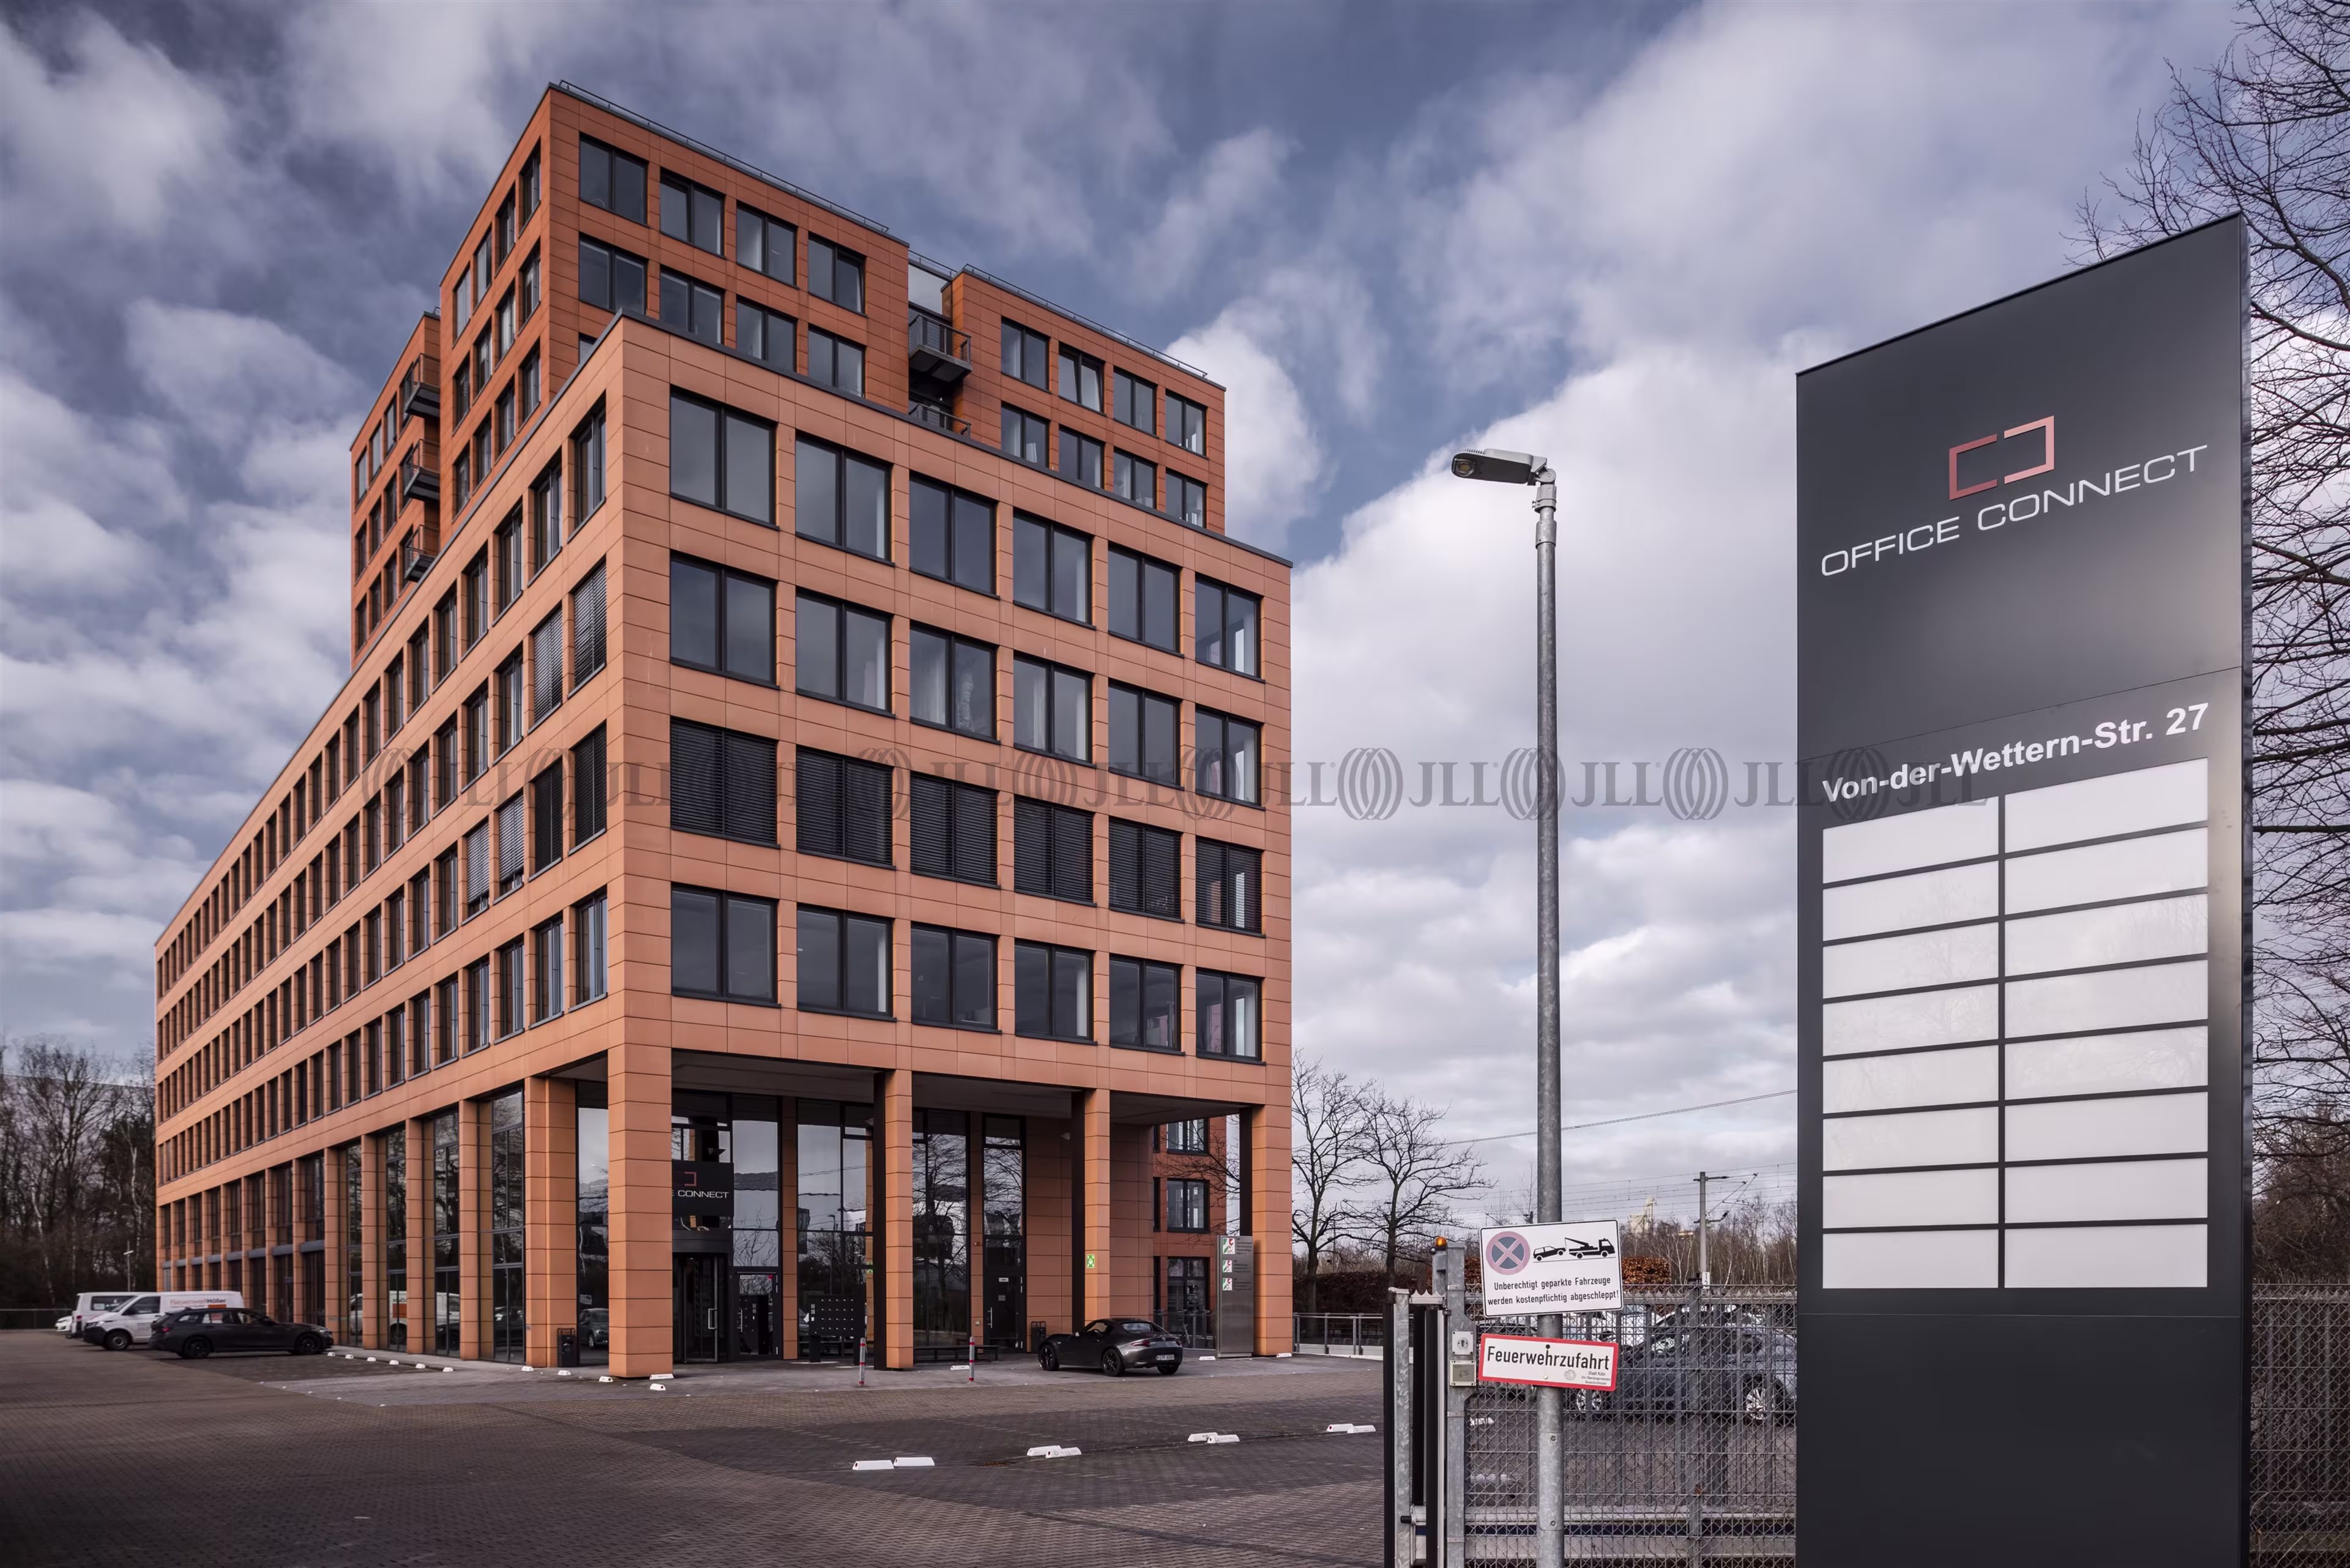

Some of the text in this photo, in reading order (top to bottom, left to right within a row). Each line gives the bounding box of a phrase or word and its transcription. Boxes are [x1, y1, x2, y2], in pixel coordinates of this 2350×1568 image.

[1821, 444, 2208, 577] OFFICE CONNECT
[1822, 703, 2209, 802] Von-der-Wettern-Str. 27
[677, 1190, 729, 1198] CONNECT
[1494, 1277, 1611, 1290] Unberechtigt geparkte Fahrzeuge
[1487, 1290, 1619, 1305] werden kostenpflichtig abgeschleppt!
[1487, 1346, 1610, 1370] Feuerwehrzufahrt
